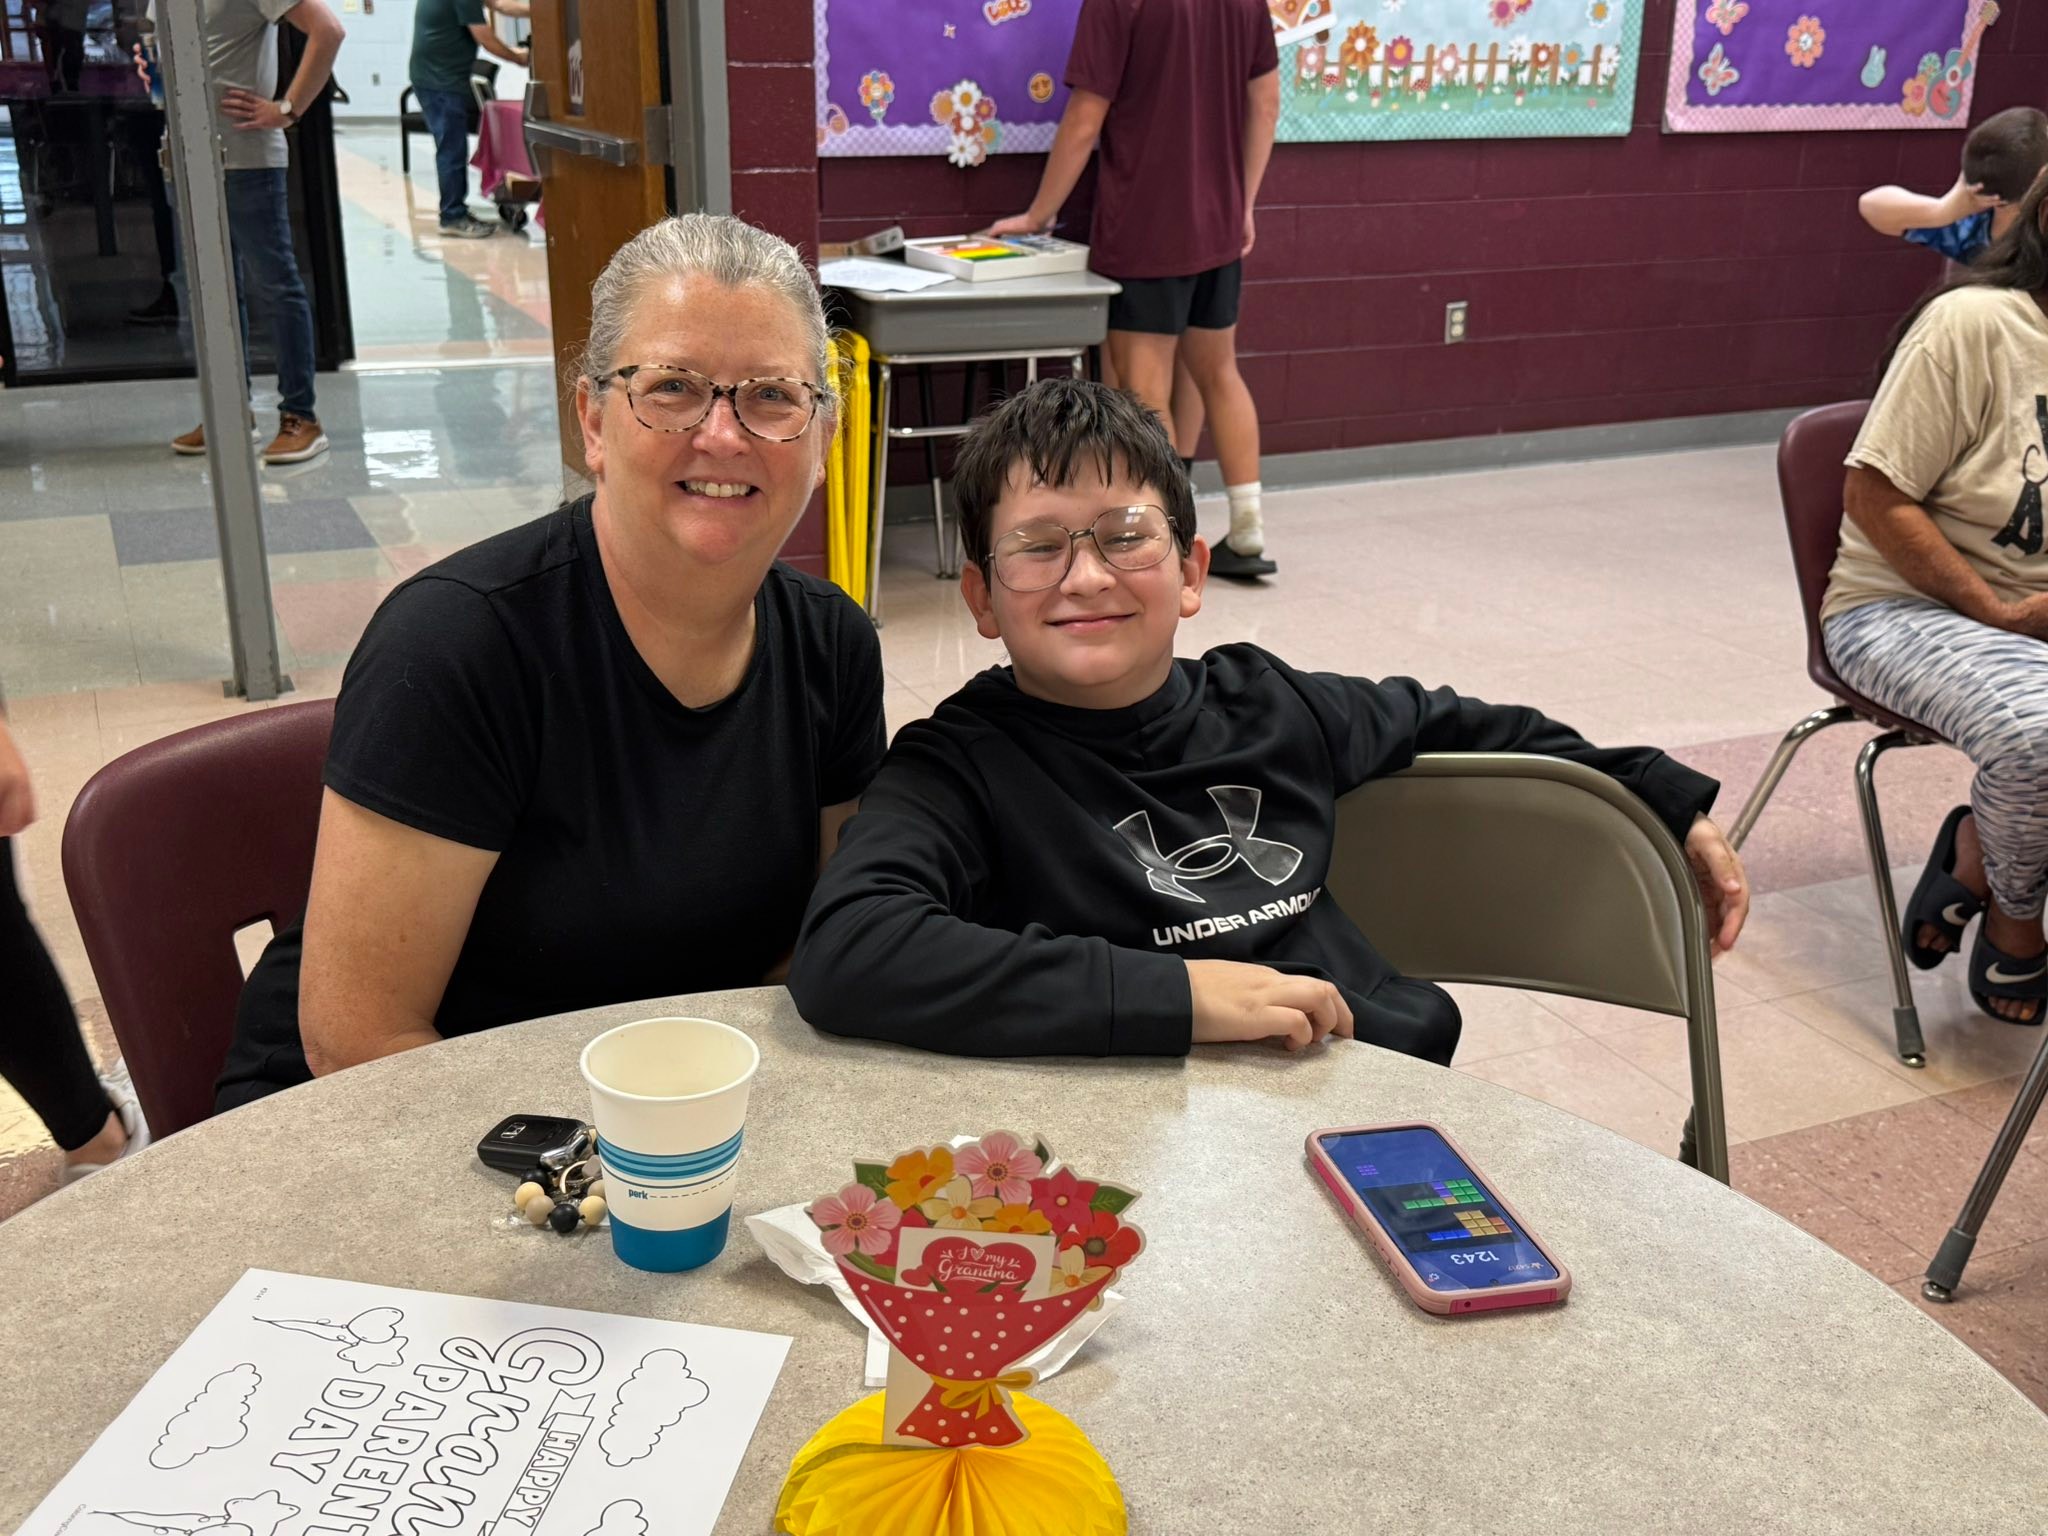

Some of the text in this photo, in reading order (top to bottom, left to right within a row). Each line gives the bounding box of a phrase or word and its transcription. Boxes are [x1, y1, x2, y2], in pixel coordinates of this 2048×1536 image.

[1152, 913, 1249, 947] UNDER
[628, 1188, 648, 1200] perk
[937, 1258, 1018, 1282] Grandma
[985, 1253, 1006, 1267] my
[1450, 1250, 1500, 1266] 1243
[270, 1377, 386, 1485] DAY
[503, 1430, 581, 1528] HAPPY
